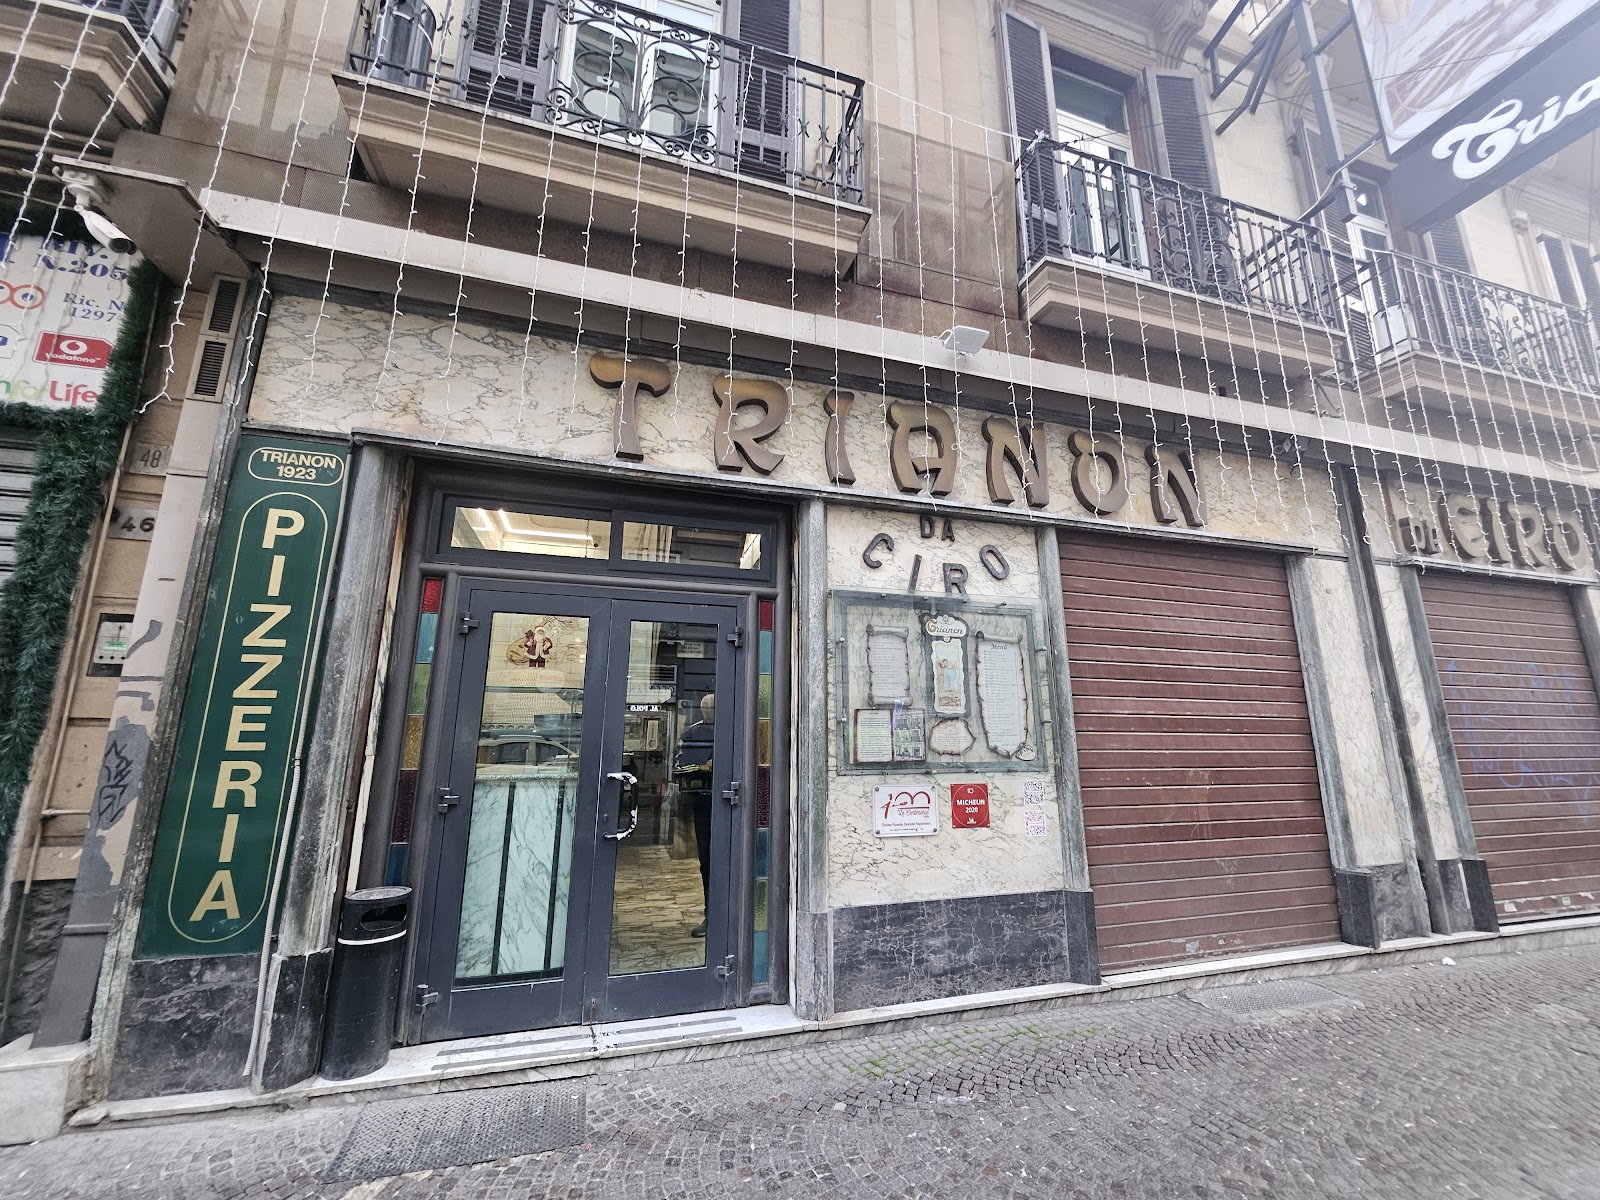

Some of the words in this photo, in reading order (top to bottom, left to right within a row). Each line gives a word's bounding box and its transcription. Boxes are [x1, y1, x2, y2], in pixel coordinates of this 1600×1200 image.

[62, 292, 100, 308] Ric.
[70, 306, 117, 323] 1297
[45, 351, 97, 364] vodafone
[589, 351, 1208, 527] TRIANON
[139, 448, 163, 469] 48
[260, 449, 337, 470] TRIANON
[276, 465, 317, 480] 1923
[919, 514, 956, 542] DA
[1437, 492, 1591, 571] CIRO
[862, 532, 1011, 601] CIRO
[188, 507, 306, 922] PIZZERIA
[956, 798, 986, 806] MICHELIN
[965, 806, 979, 814] 2020
